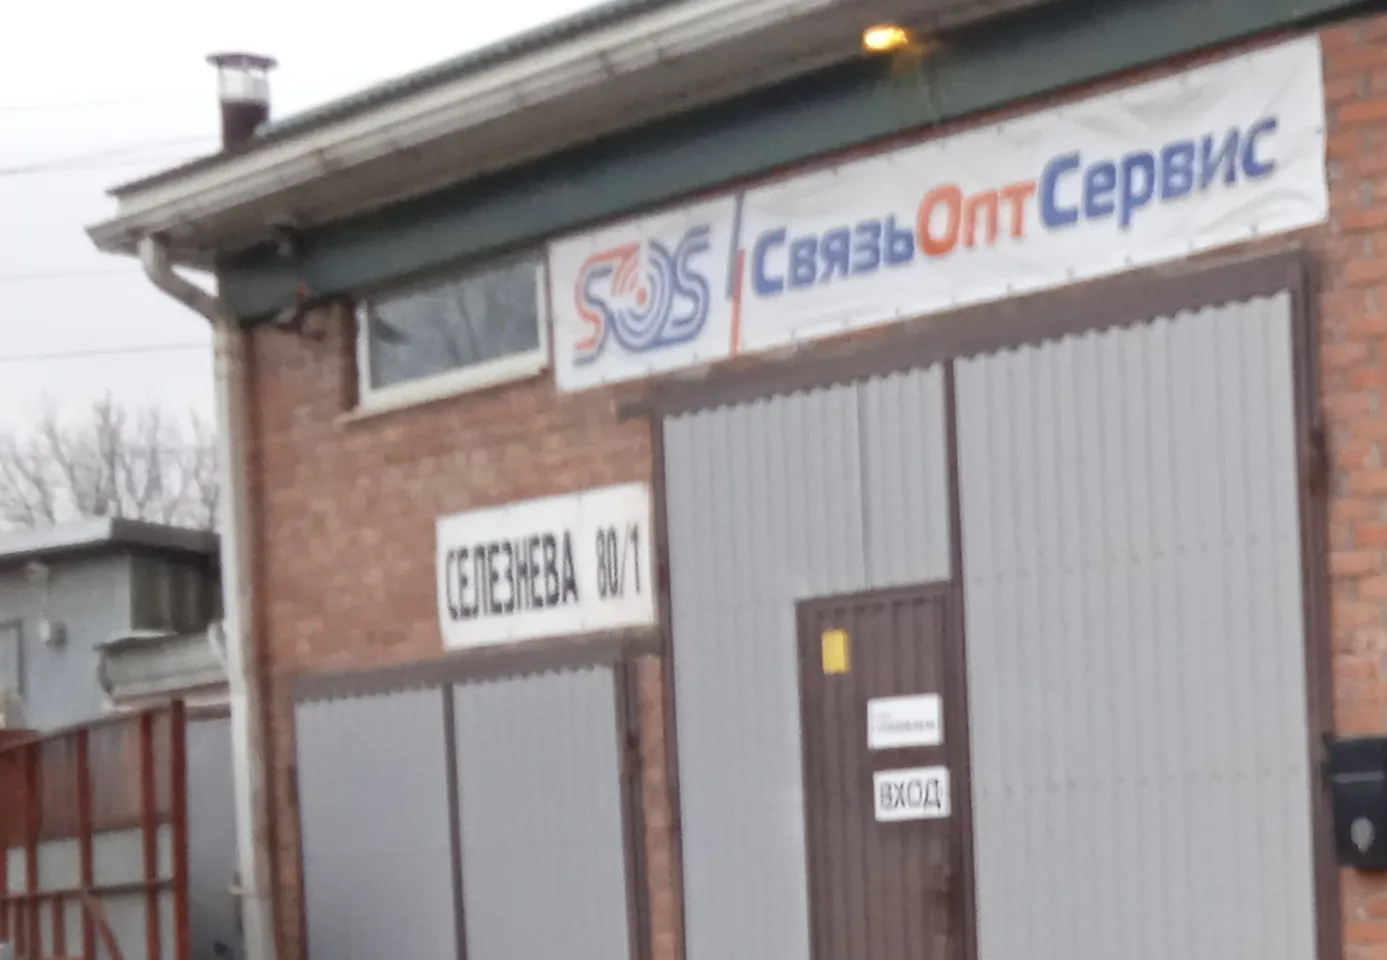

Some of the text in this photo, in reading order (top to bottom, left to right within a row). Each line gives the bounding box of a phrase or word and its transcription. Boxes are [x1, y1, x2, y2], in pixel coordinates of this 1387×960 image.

[752, 117, 1277, 297] СвязьОптСервис
[446, 521, 640, 620] СЕЛЕЗНЕВА 80/1
[880, 778, 941, 809] ВХОД
